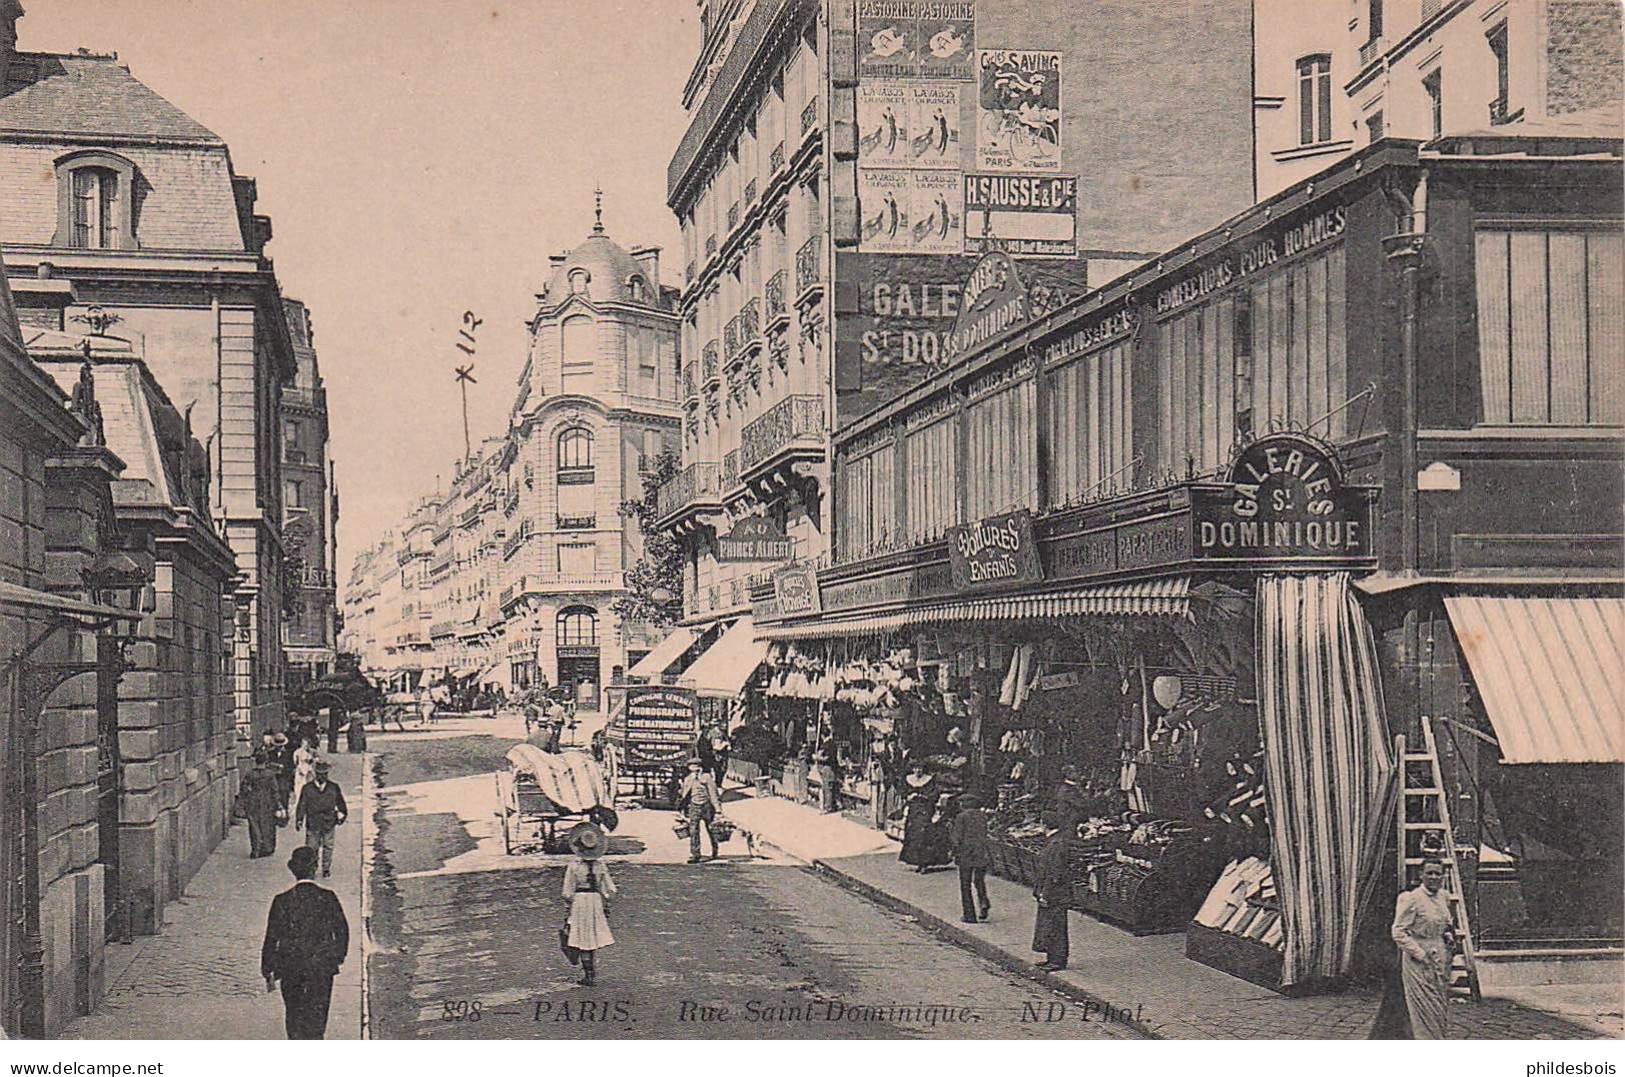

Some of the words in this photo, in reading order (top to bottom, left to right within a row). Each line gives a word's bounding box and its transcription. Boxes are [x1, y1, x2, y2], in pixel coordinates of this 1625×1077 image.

[861, 2, 917, 19] PASTORINE
[919, 3, 974, 21] PASTORINE
[1009, 53, 1059, 73] SAVING
[985, 157, 1013, 167] PARIS
[1157, 258, 1232, 314] CONFECTIONS
[1240, 239, 1278, 277] POUR
[1284, 205, 1346, 258] HOMMES
[1233, 447, 1335, 518] GALERIES
[744, 524, 768, 535] AU
[957, 518, 1020, 558] VOITURES
[1201, 521, 1360, 550] DOMINIQUE
[720, 541, 755, 558] PRINCE
[756, 540, 789, 558] ALBERT
[969, 553, 1018, 582] ENFANTS
